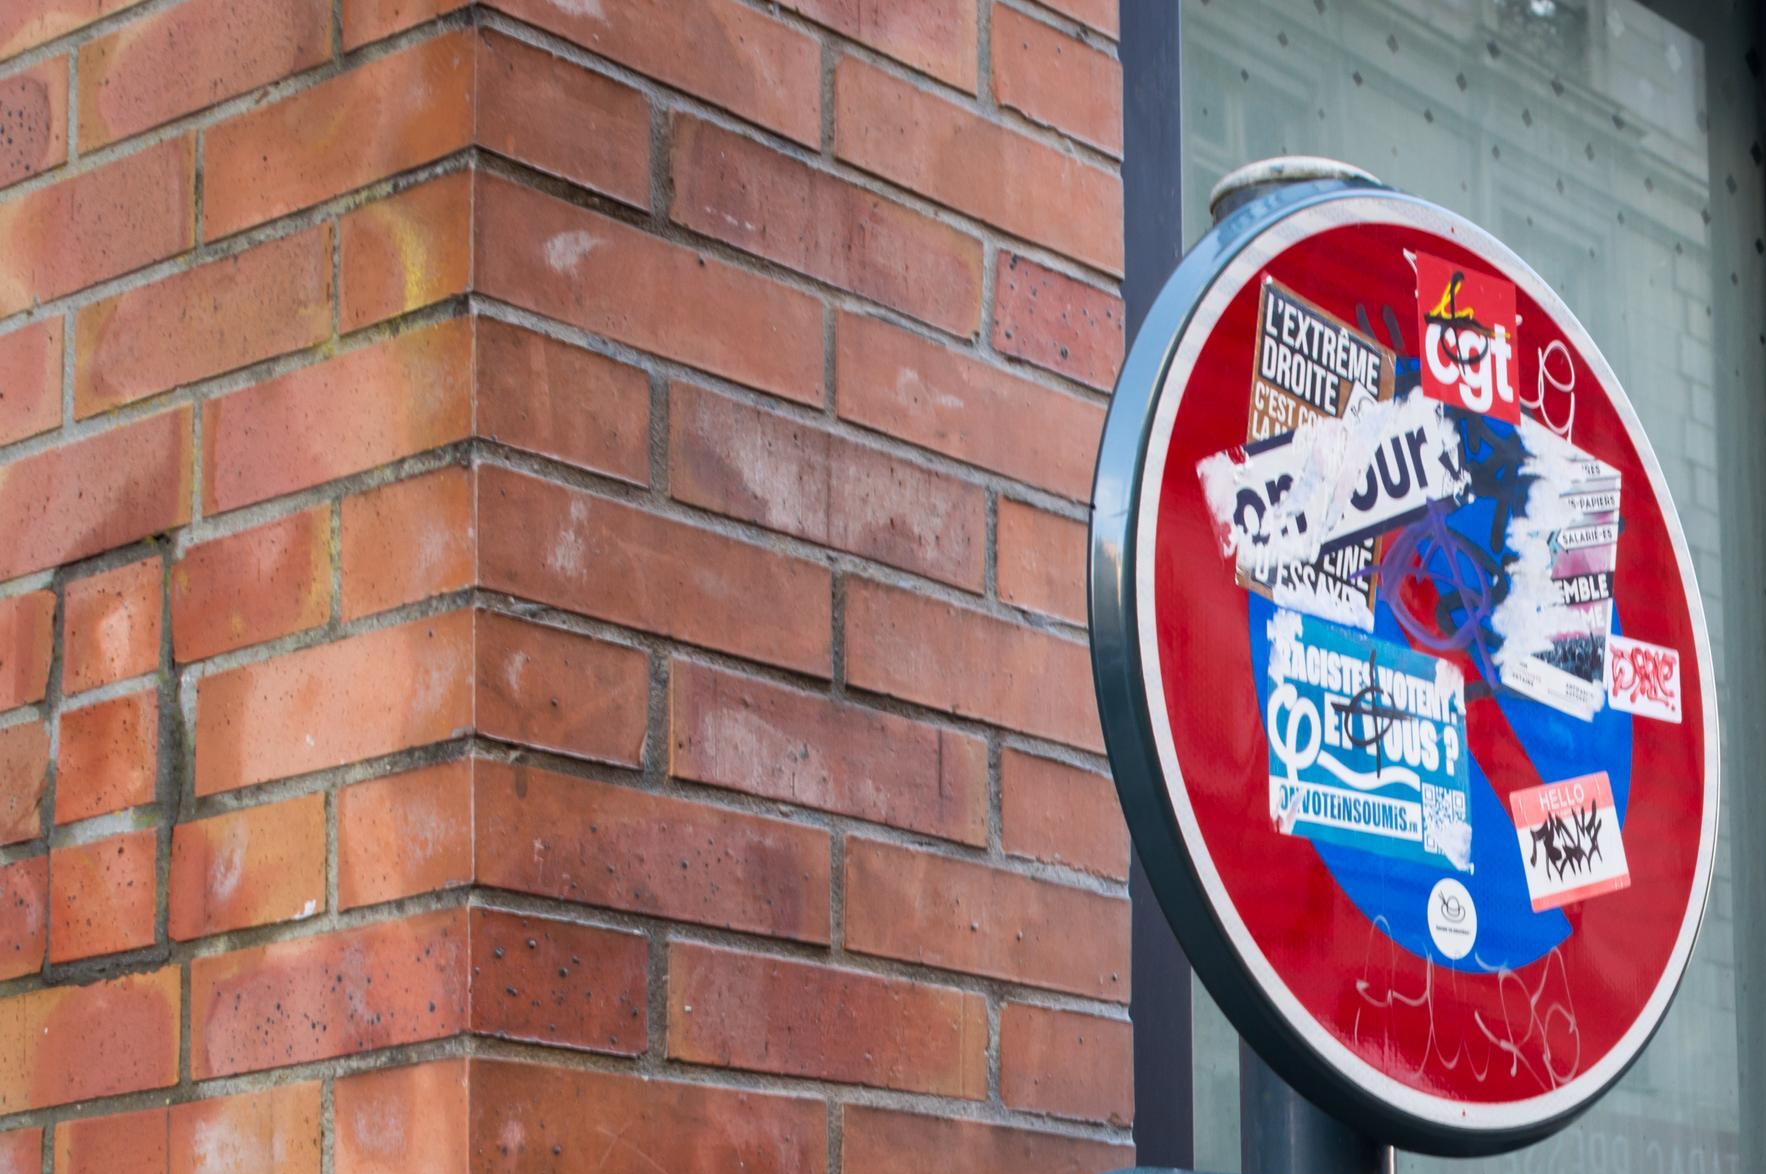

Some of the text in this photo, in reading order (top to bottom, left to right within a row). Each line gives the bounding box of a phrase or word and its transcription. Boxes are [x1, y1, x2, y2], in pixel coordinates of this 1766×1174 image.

[1261, 335, 1340, 416] DROITE
[1266, 292, 1380, 396] L'EXTRÊME
[1425, 323, 1514, 414] cgt
[1252, 411, 1271, 443] LA
[1254, 380, 1297, 428] C'EST
[1360, 701, 1439, 773] VOUS
[1444, 726, 1459, 776] ?
[1539, 783, 1585, 811] HELLO
